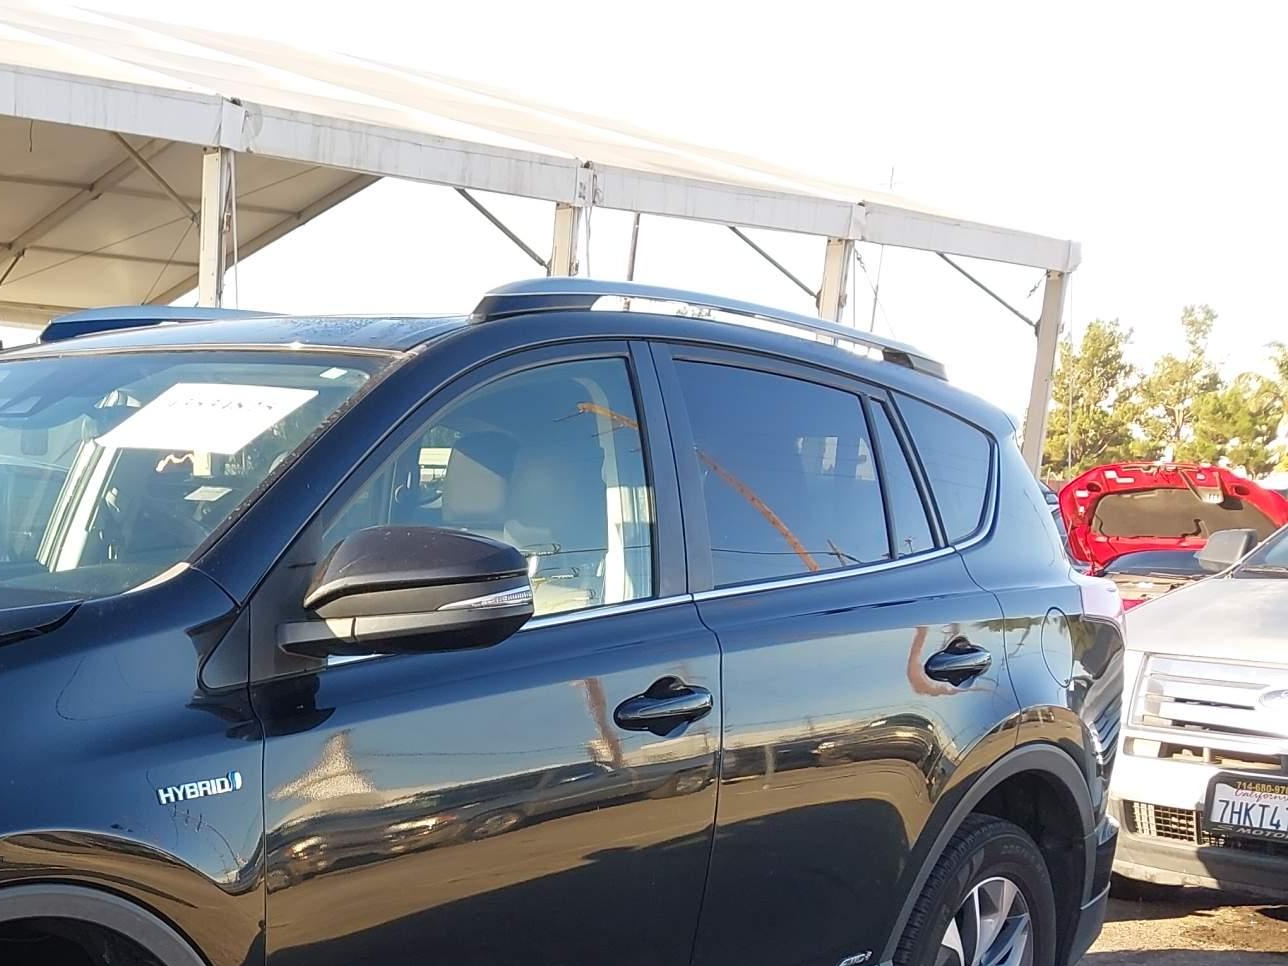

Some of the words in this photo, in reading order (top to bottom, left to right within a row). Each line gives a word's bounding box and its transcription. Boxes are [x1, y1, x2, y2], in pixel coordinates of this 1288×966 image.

[158, 777, 232, 804] HYBRID
[1218, 799, 1288, 830] 7HKT4
[1236, 827, 1288, 839] MOTO
